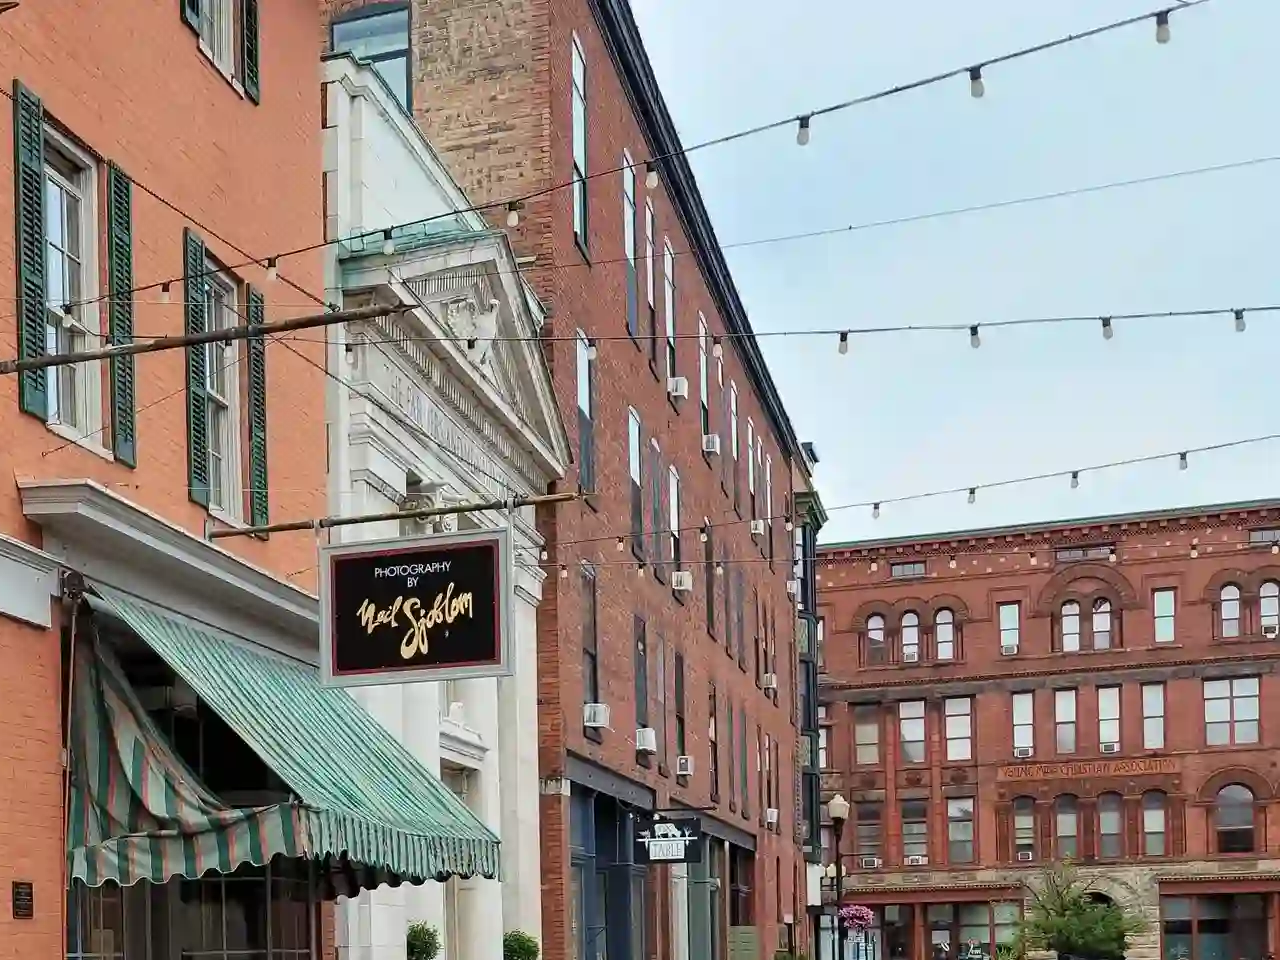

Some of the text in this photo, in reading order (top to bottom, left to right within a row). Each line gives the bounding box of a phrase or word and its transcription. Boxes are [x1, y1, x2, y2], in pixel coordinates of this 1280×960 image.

[374, 560, 452, 578] PHOTOGRAPHY
[407, 577, 419, 588] BY
[651, 843, 682, 857] TABLE
